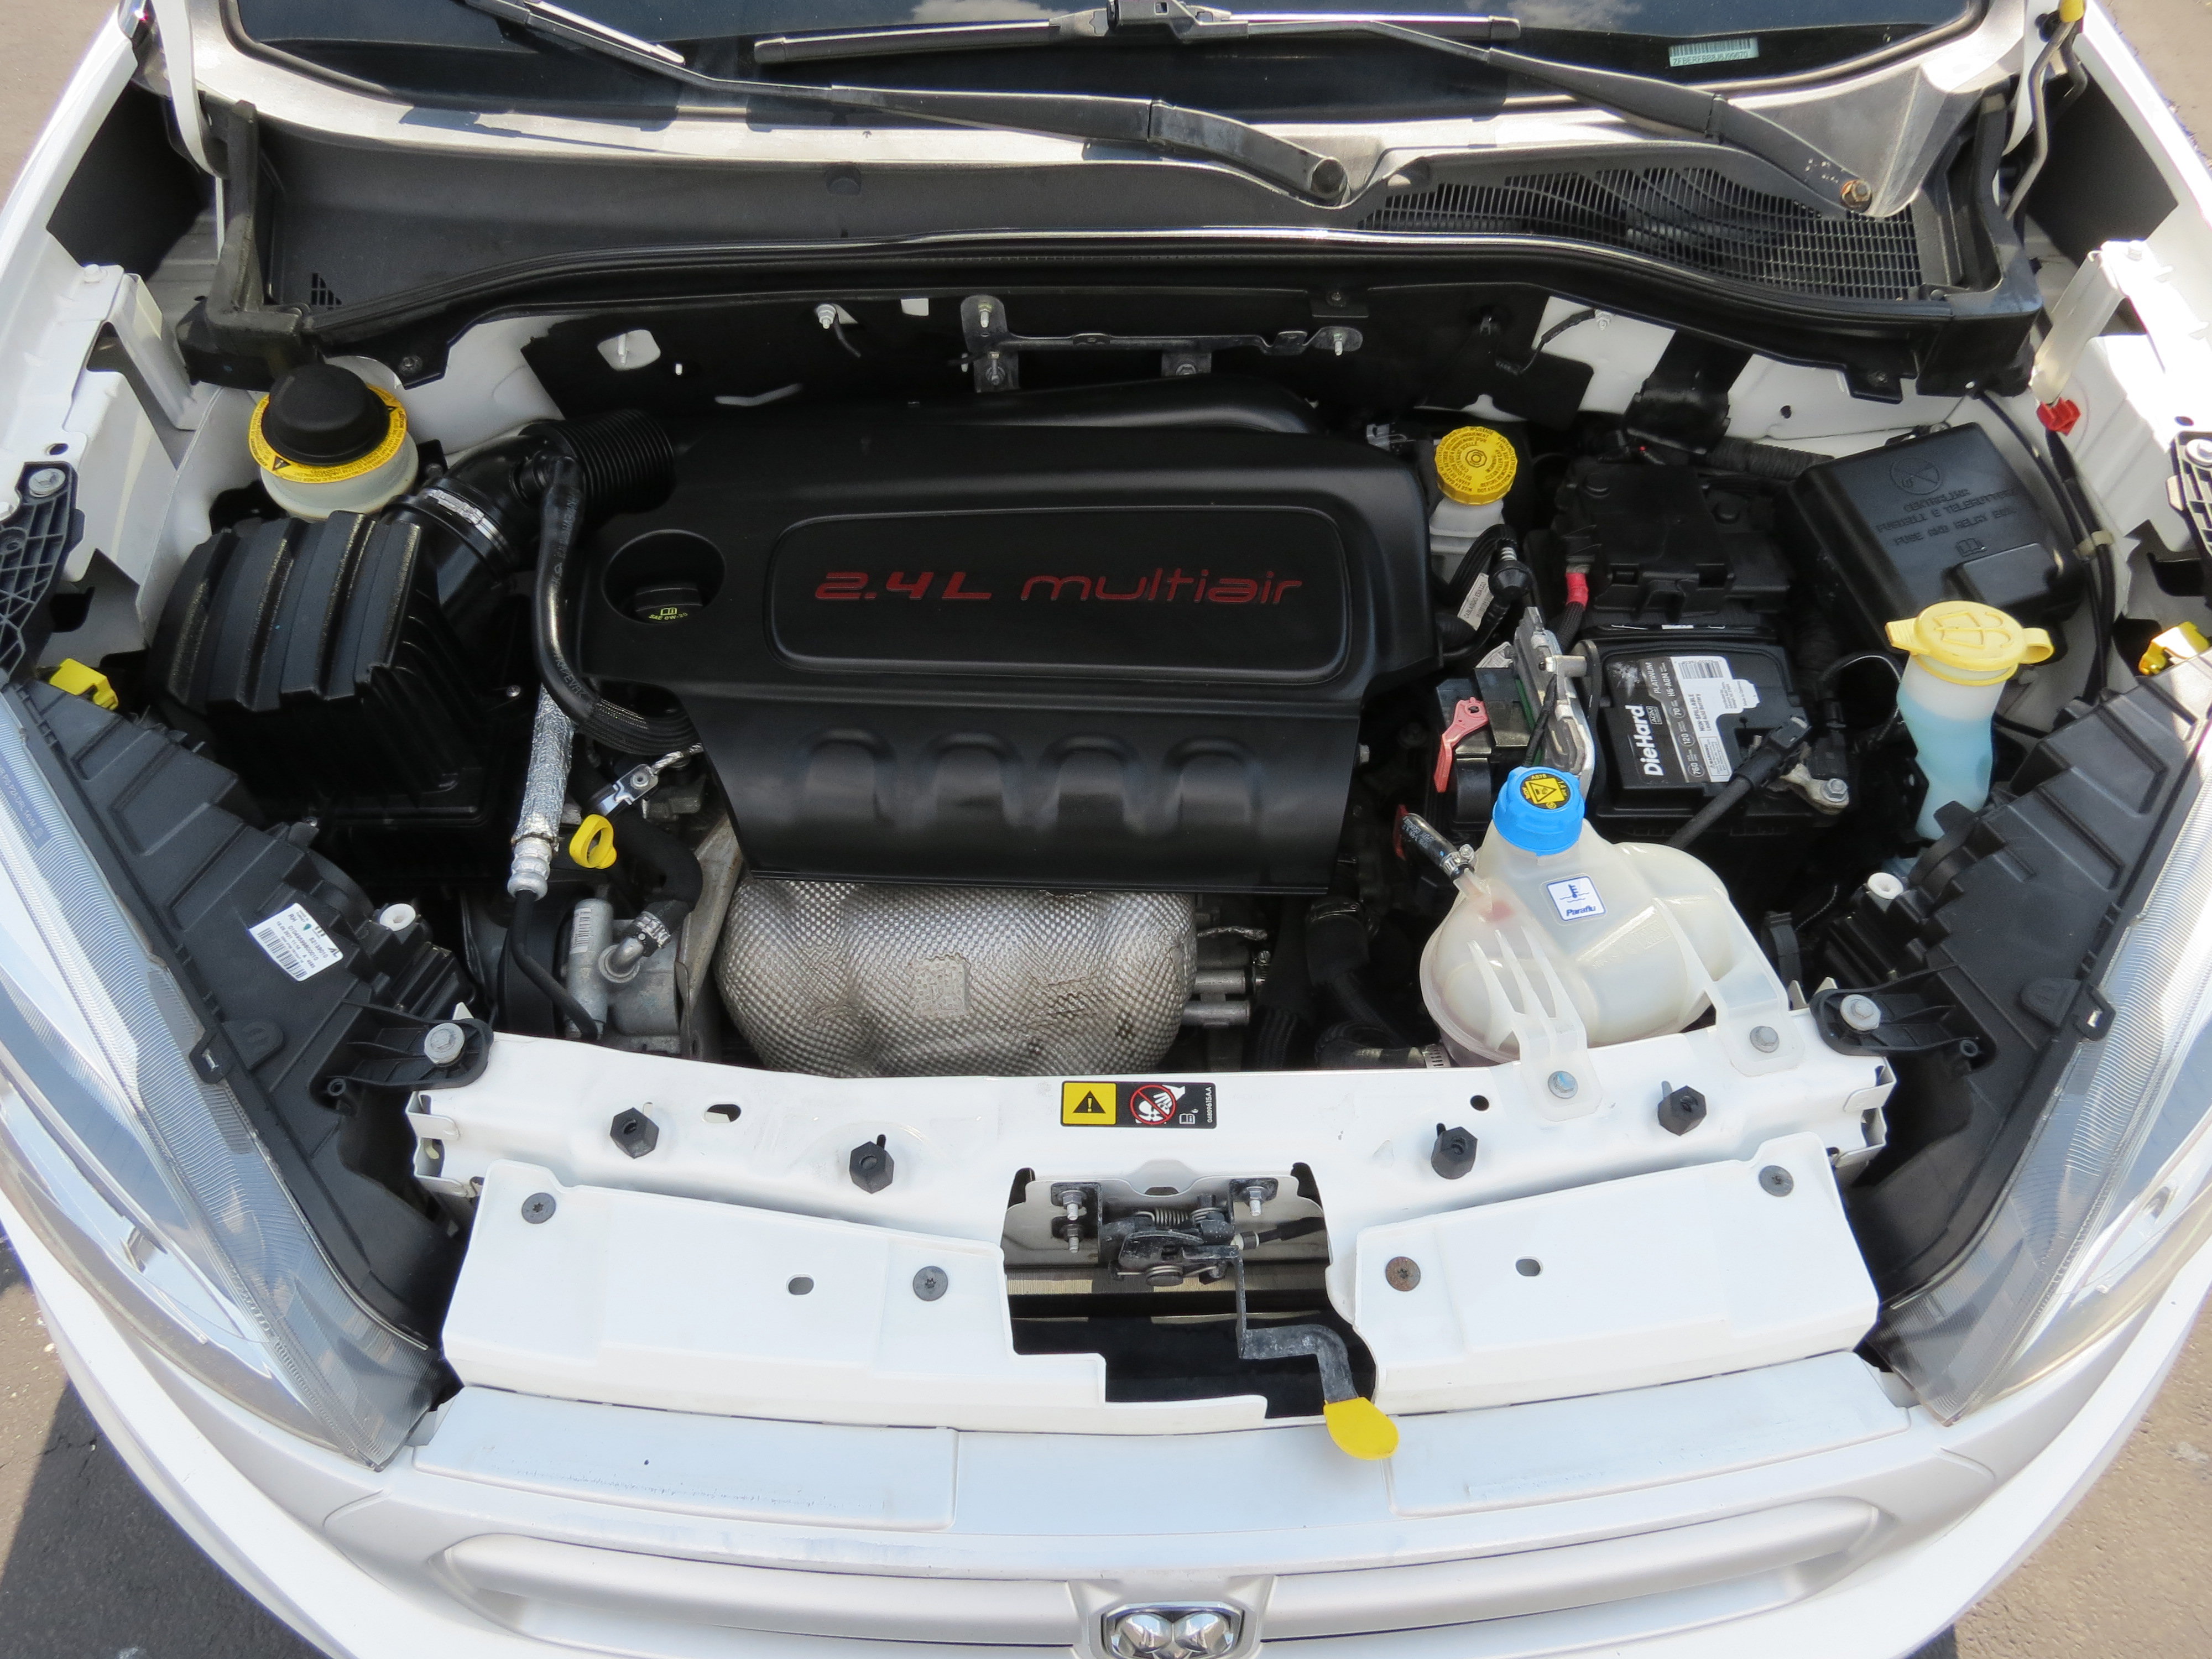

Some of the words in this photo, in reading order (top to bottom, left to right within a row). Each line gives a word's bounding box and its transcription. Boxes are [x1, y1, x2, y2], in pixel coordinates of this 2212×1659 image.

[1931, 509, 1941, 518] E
[1895, 532, 1924, 545] FUSE
[1928, 525, 1950, 537] AND
[1953, 514, 1987, 529] RELAY
[1020, 567, 1302, 604] multiair
[664, 612, 688, 620] 0W-20
[1645, 662, 1661, 693] PLATINUM
[1661, 672, 1676, 697] H6-AGM
[1695, 693, 1706, 710] Battery
[1673, 708, 1681, 716] 70
[1688, 693, 1705, 732] NON-SPILLABLE
[1625, 705, 1664, 776] DieHard
[1681, 733, 1691, 744] 120
[1690, 762, 1701, 775] 760
[288, 914, 298, 922] RH
[1566, 905, 1596, 916] Paraflu
